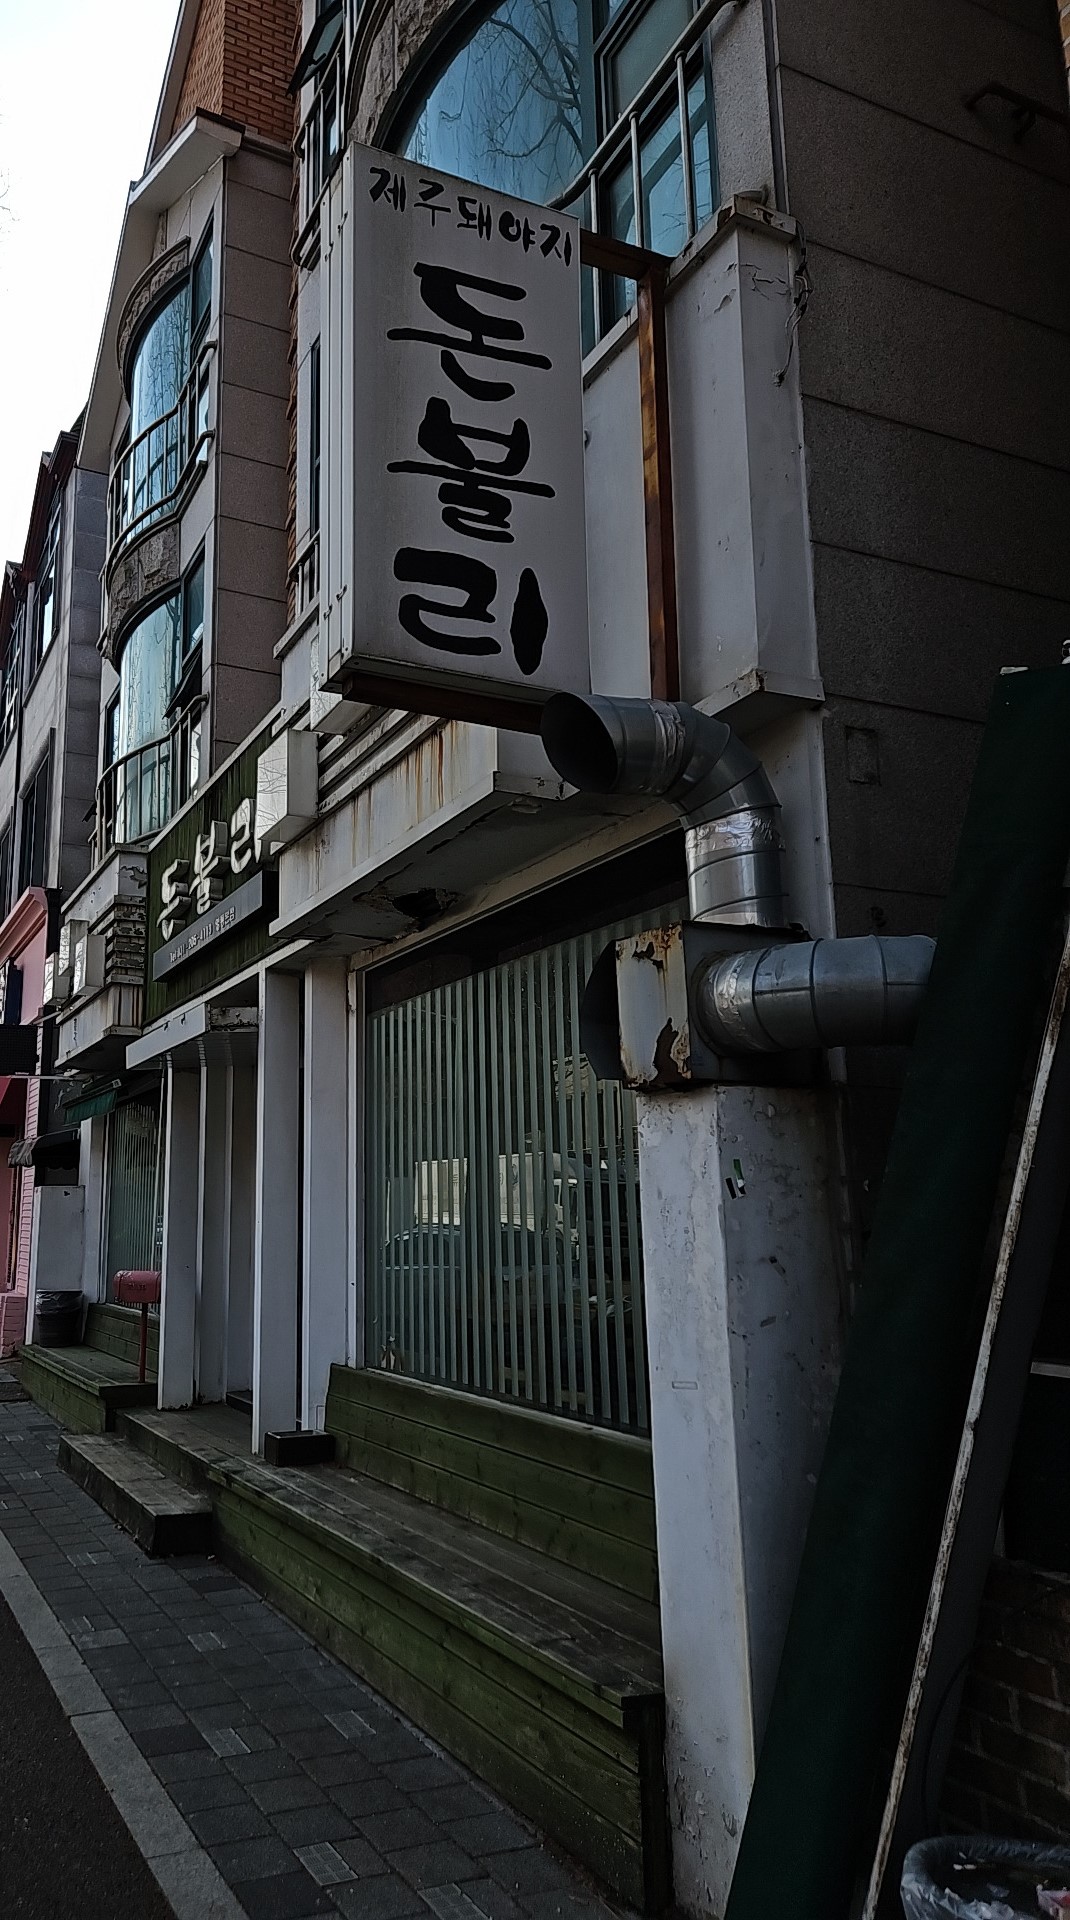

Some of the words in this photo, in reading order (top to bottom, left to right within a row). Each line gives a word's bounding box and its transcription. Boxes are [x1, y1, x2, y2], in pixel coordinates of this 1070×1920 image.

[369, 167, 573, 267] 제주돼야지
[387, 262, 555, 676] 돈불리
[156, 798, 262, 942] 돈불리
